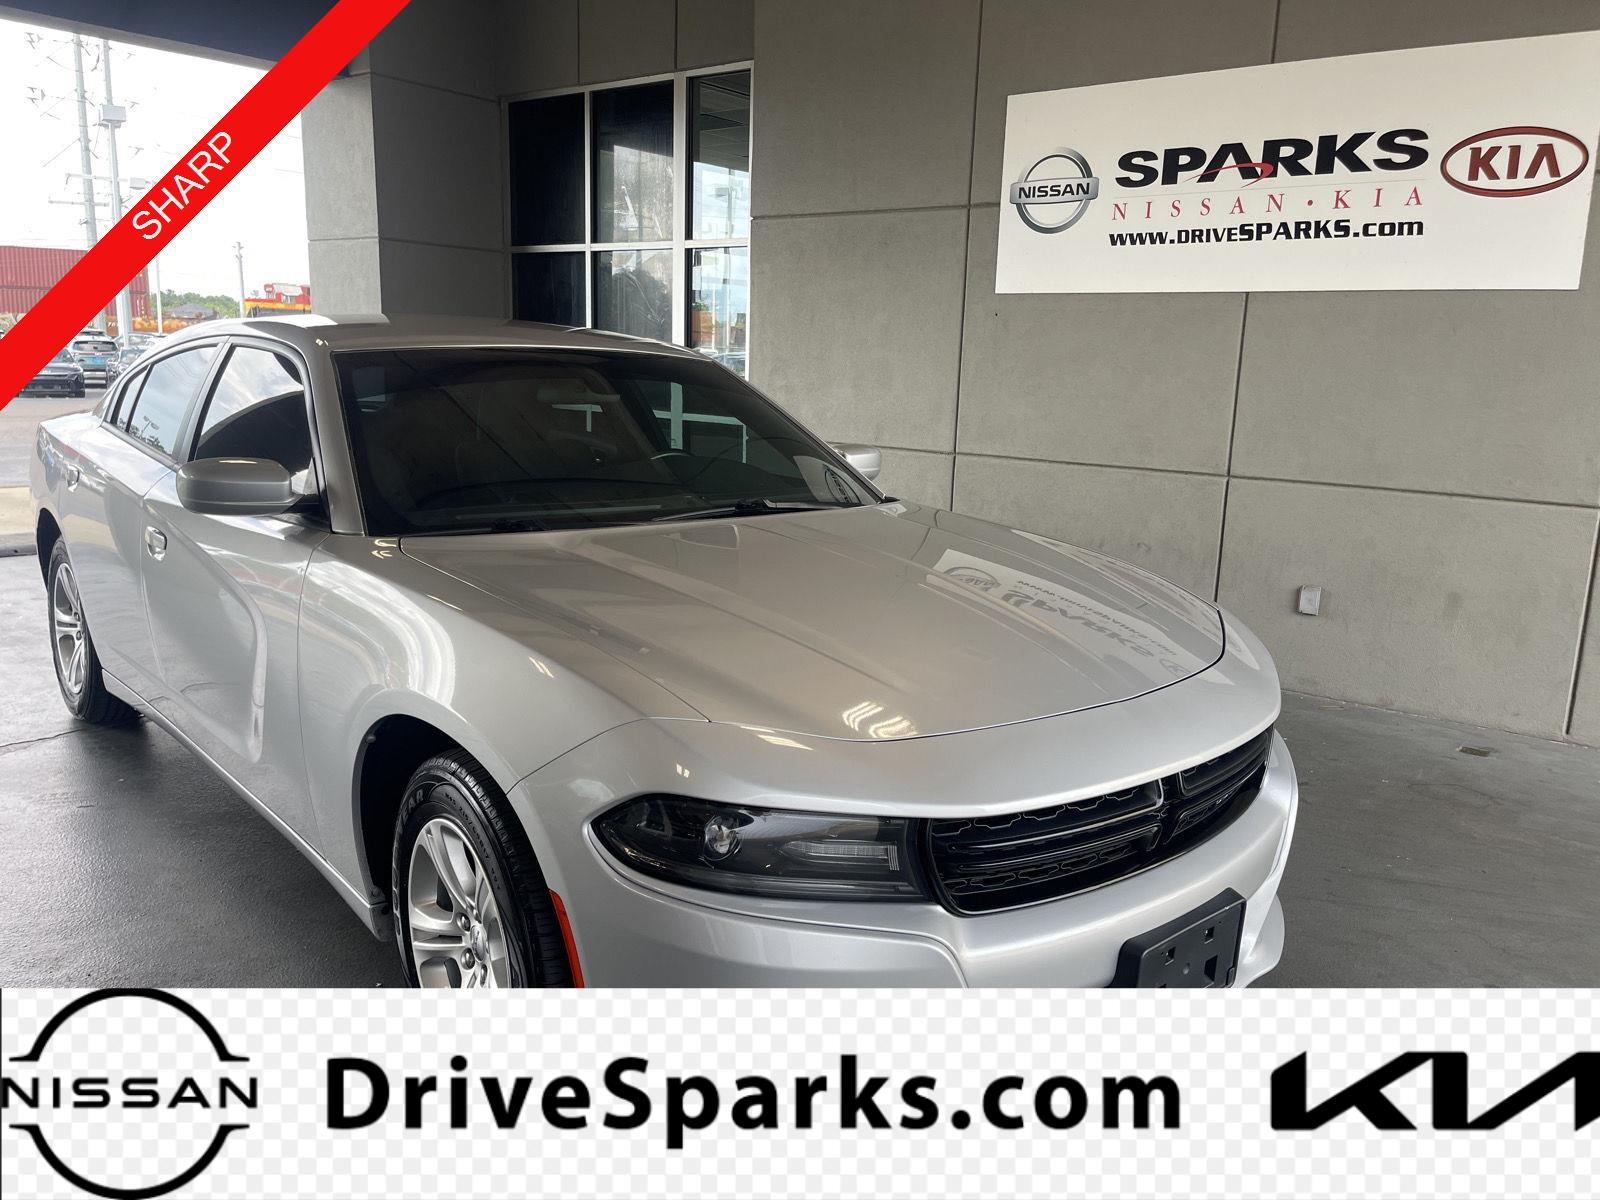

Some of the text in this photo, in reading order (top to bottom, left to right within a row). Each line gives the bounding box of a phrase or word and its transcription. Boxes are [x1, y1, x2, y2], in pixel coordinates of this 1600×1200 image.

[1114, 128, 1430, 188] SPARKS
[1467, 142, 1562, 182] KIA
[1018, 182, 1091, 199] NISSAN
[1111, 185, 1424, 221] NISSAN KIA
[1108, 218, 1425, 247] www.DRIVESPARKS.com
